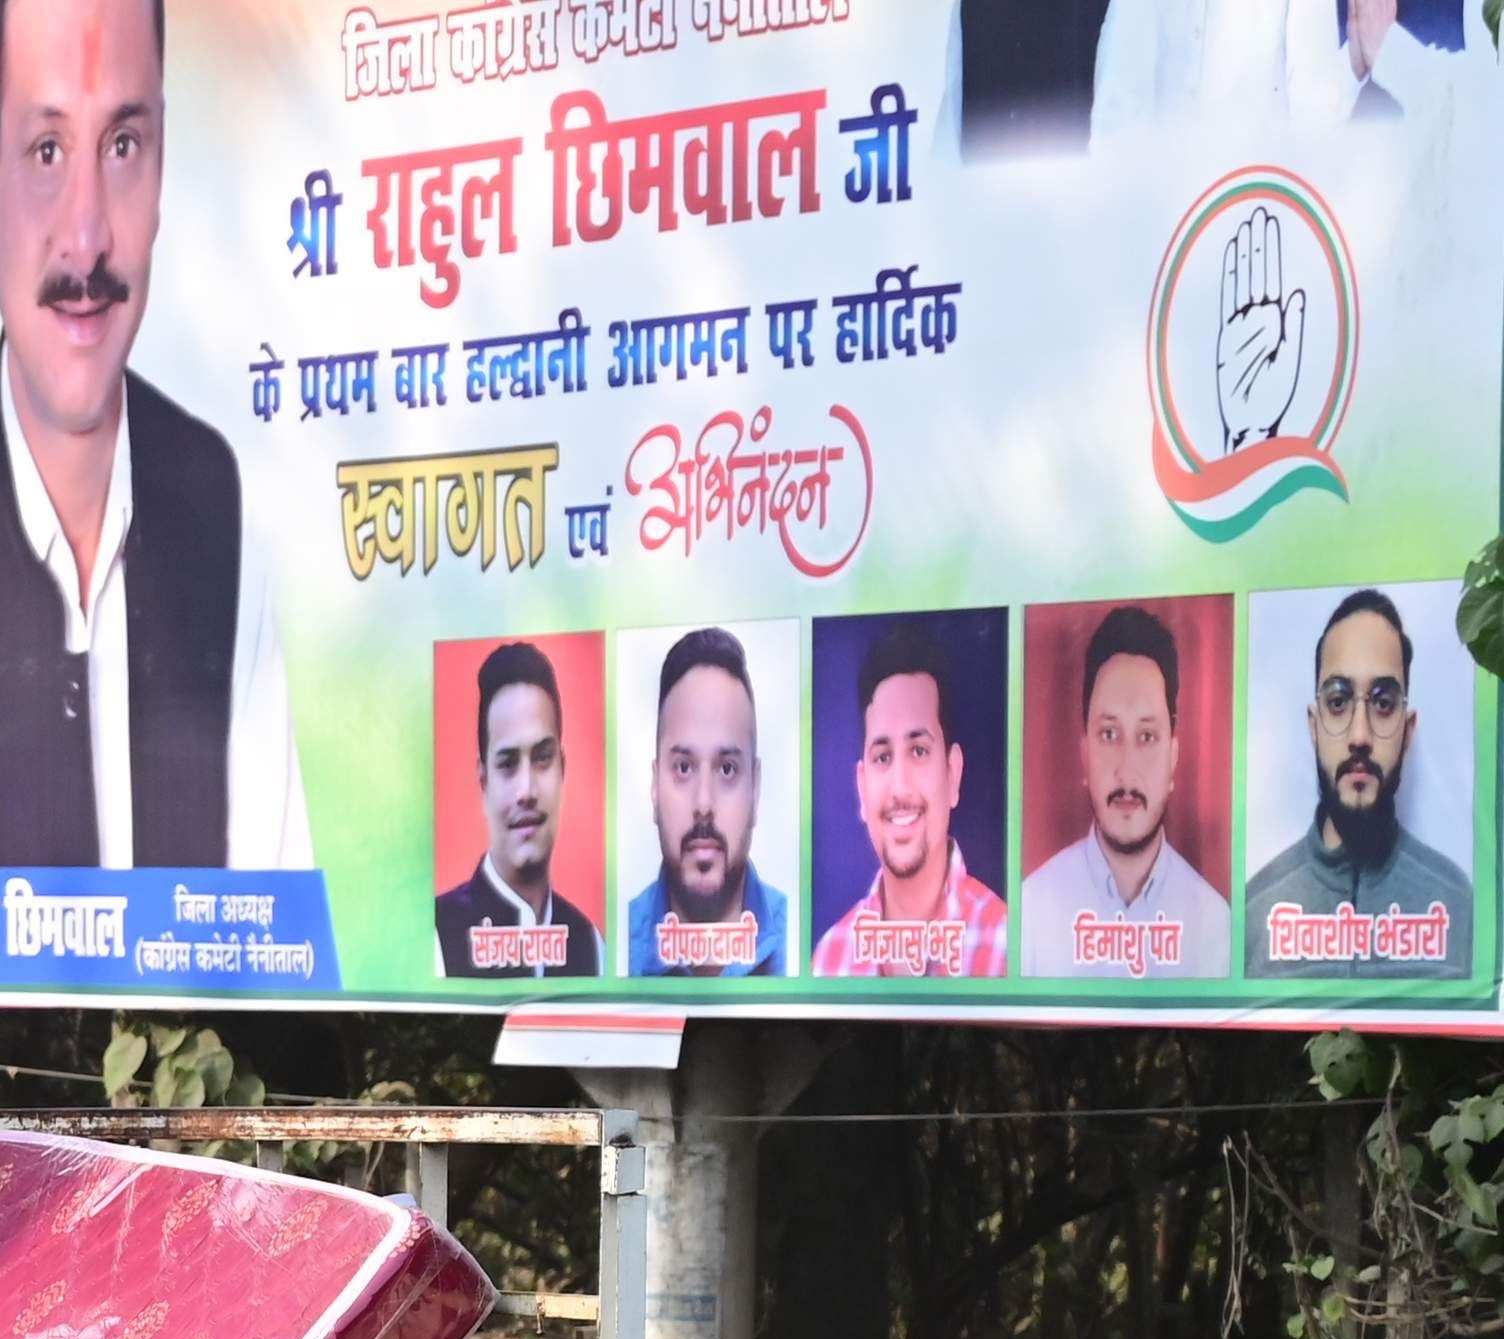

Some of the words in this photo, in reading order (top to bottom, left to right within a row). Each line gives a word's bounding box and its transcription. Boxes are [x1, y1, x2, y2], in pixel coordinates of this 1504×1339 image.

[342, 4, 440, 101] जिला
[287, 169, 342, 278] श्री
[361, 138, 523, 308] राहुल
[545, 90, 827, 247] छिमवाल
[839, 83, 917, 204] जी
[249, 343, 284, 422] के
[299, 350, 378, 421] प्रथम
[392, 343, 449, 408] बार
[463, 307, 590, 401] हल्द्वानी
[607, 306, 749, 388] आगमन
[766, 298, 817, 369] पर
[834, 266, 962, 363] हार्दिक
[336, 442, 559, 580] स्वागत
[565, 486, 613, 558] एवं
[625, 404, 872, 578] अभिनंदन
[5, 878, 126, 957] छिमवाल
[175, 885, 215, 924] जिला
[221, 894, 274, 930] अध्यक्ष
[657, 913, 707, 965] दीपक
[710, 913, 757, 965] दानी
[1269, 902, 1370, 962] शिवाशीष
[1375, 902, 1448, 961] भंडारी
[136, 931, 190, 975] (कांग्रेस
[195, 931, 241, 974] कमेटी
[246, 932, 314, 980] नैनीताल)
[471, 918, 520, 967] संजय
[523, 925, 568, 967] रावत
[1074, 912, 1145, 978] हिमांशु
[1148, 920, 1182, 966] पंत
